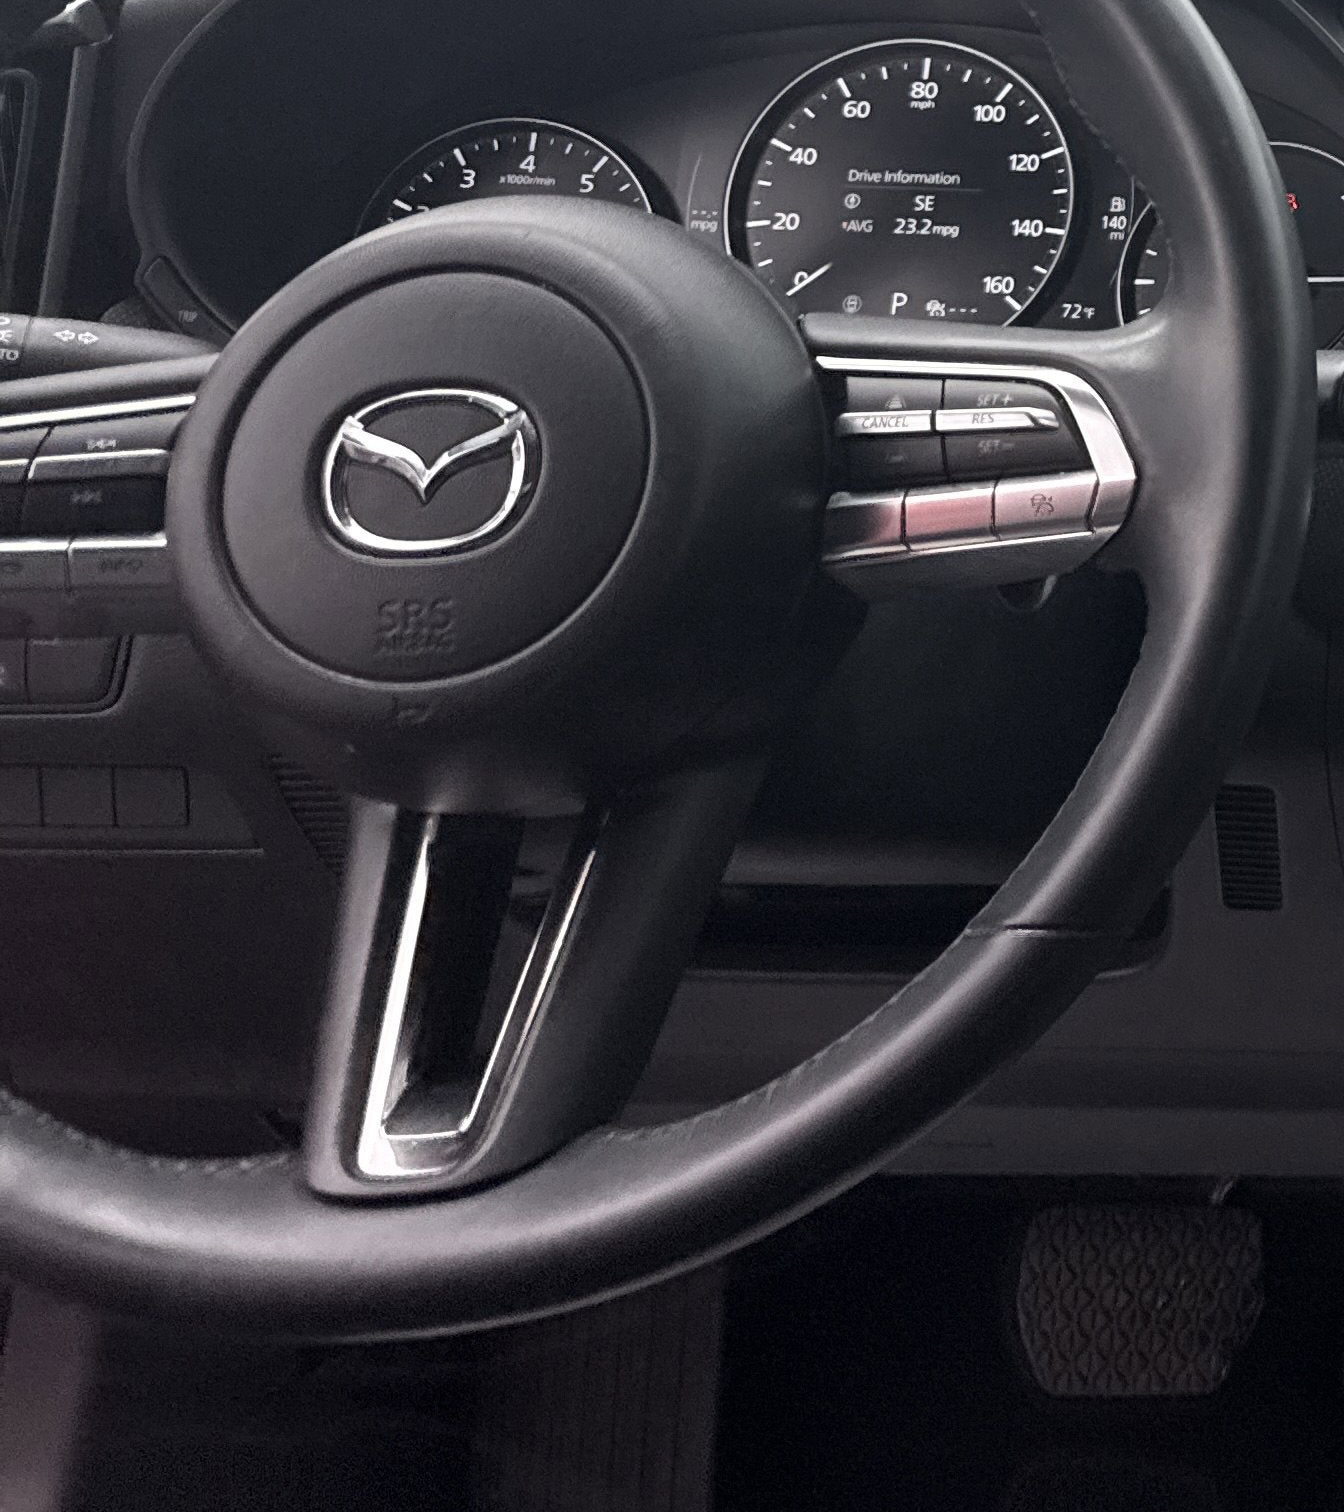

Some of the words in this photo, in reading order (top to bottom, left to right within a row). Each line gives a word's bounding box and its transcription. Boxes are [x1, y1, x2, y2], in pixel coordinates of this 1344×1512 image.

[911, 82, 938, 99] 80
[843, 101, 870, 118] 60
[910, 99, 935, 110] mph
[974, 105, 1005, 122] 100
[520, 155, 536, 172] 4
[790, 147, 817, 165] 40
[1010, 154, 1039, 171] 120
[460, 169, 475, 188] 3
[580, 174, 595, 192] 5
[848, 169, 881, 182] Drive
[884, 170, 960, 184] Information
[914, 195, 935, 211] SE
[691, 219, 718, 232] mpg
[772, 213, 799, 230] 20
[847, 220, 873, 233] AVG
[894, 220, 931, 234] 23.2
[1012, 220, 1042, 236] 140
[1102, 216, 1127, 230] 140
[983, 276, 1014, 293] 160
[890, 293, 907, 314] P
[862, 416, 909, 428] CANCEL
[972, 413, 994, 425] RES
